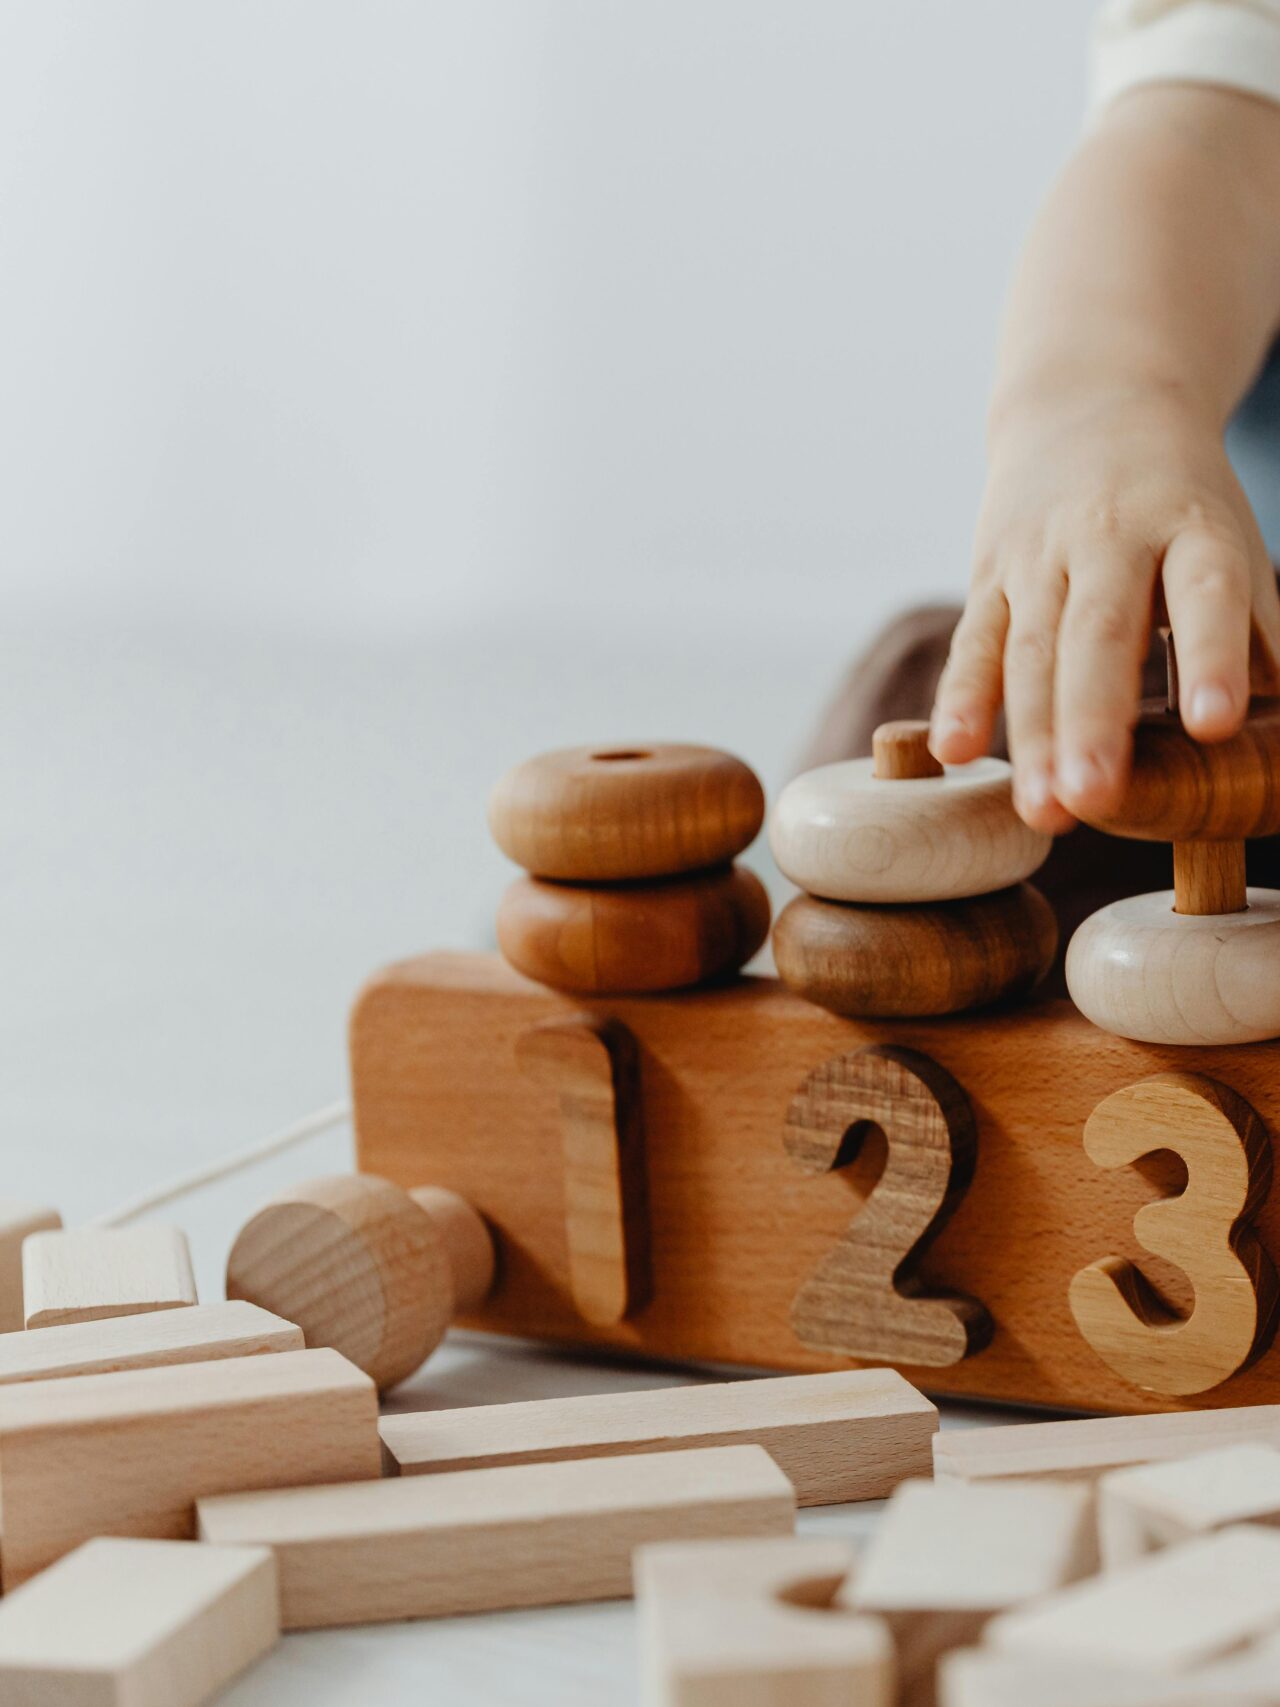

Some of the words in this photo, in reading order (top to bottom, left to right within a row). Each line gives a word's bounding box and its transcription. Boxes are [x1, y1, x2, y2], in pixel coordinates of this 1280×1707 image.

[514, 1020, 643, 1327] 1
[784, 1045, 990, 1368] 2
[1069, 1073, 1277, 1395] 3
